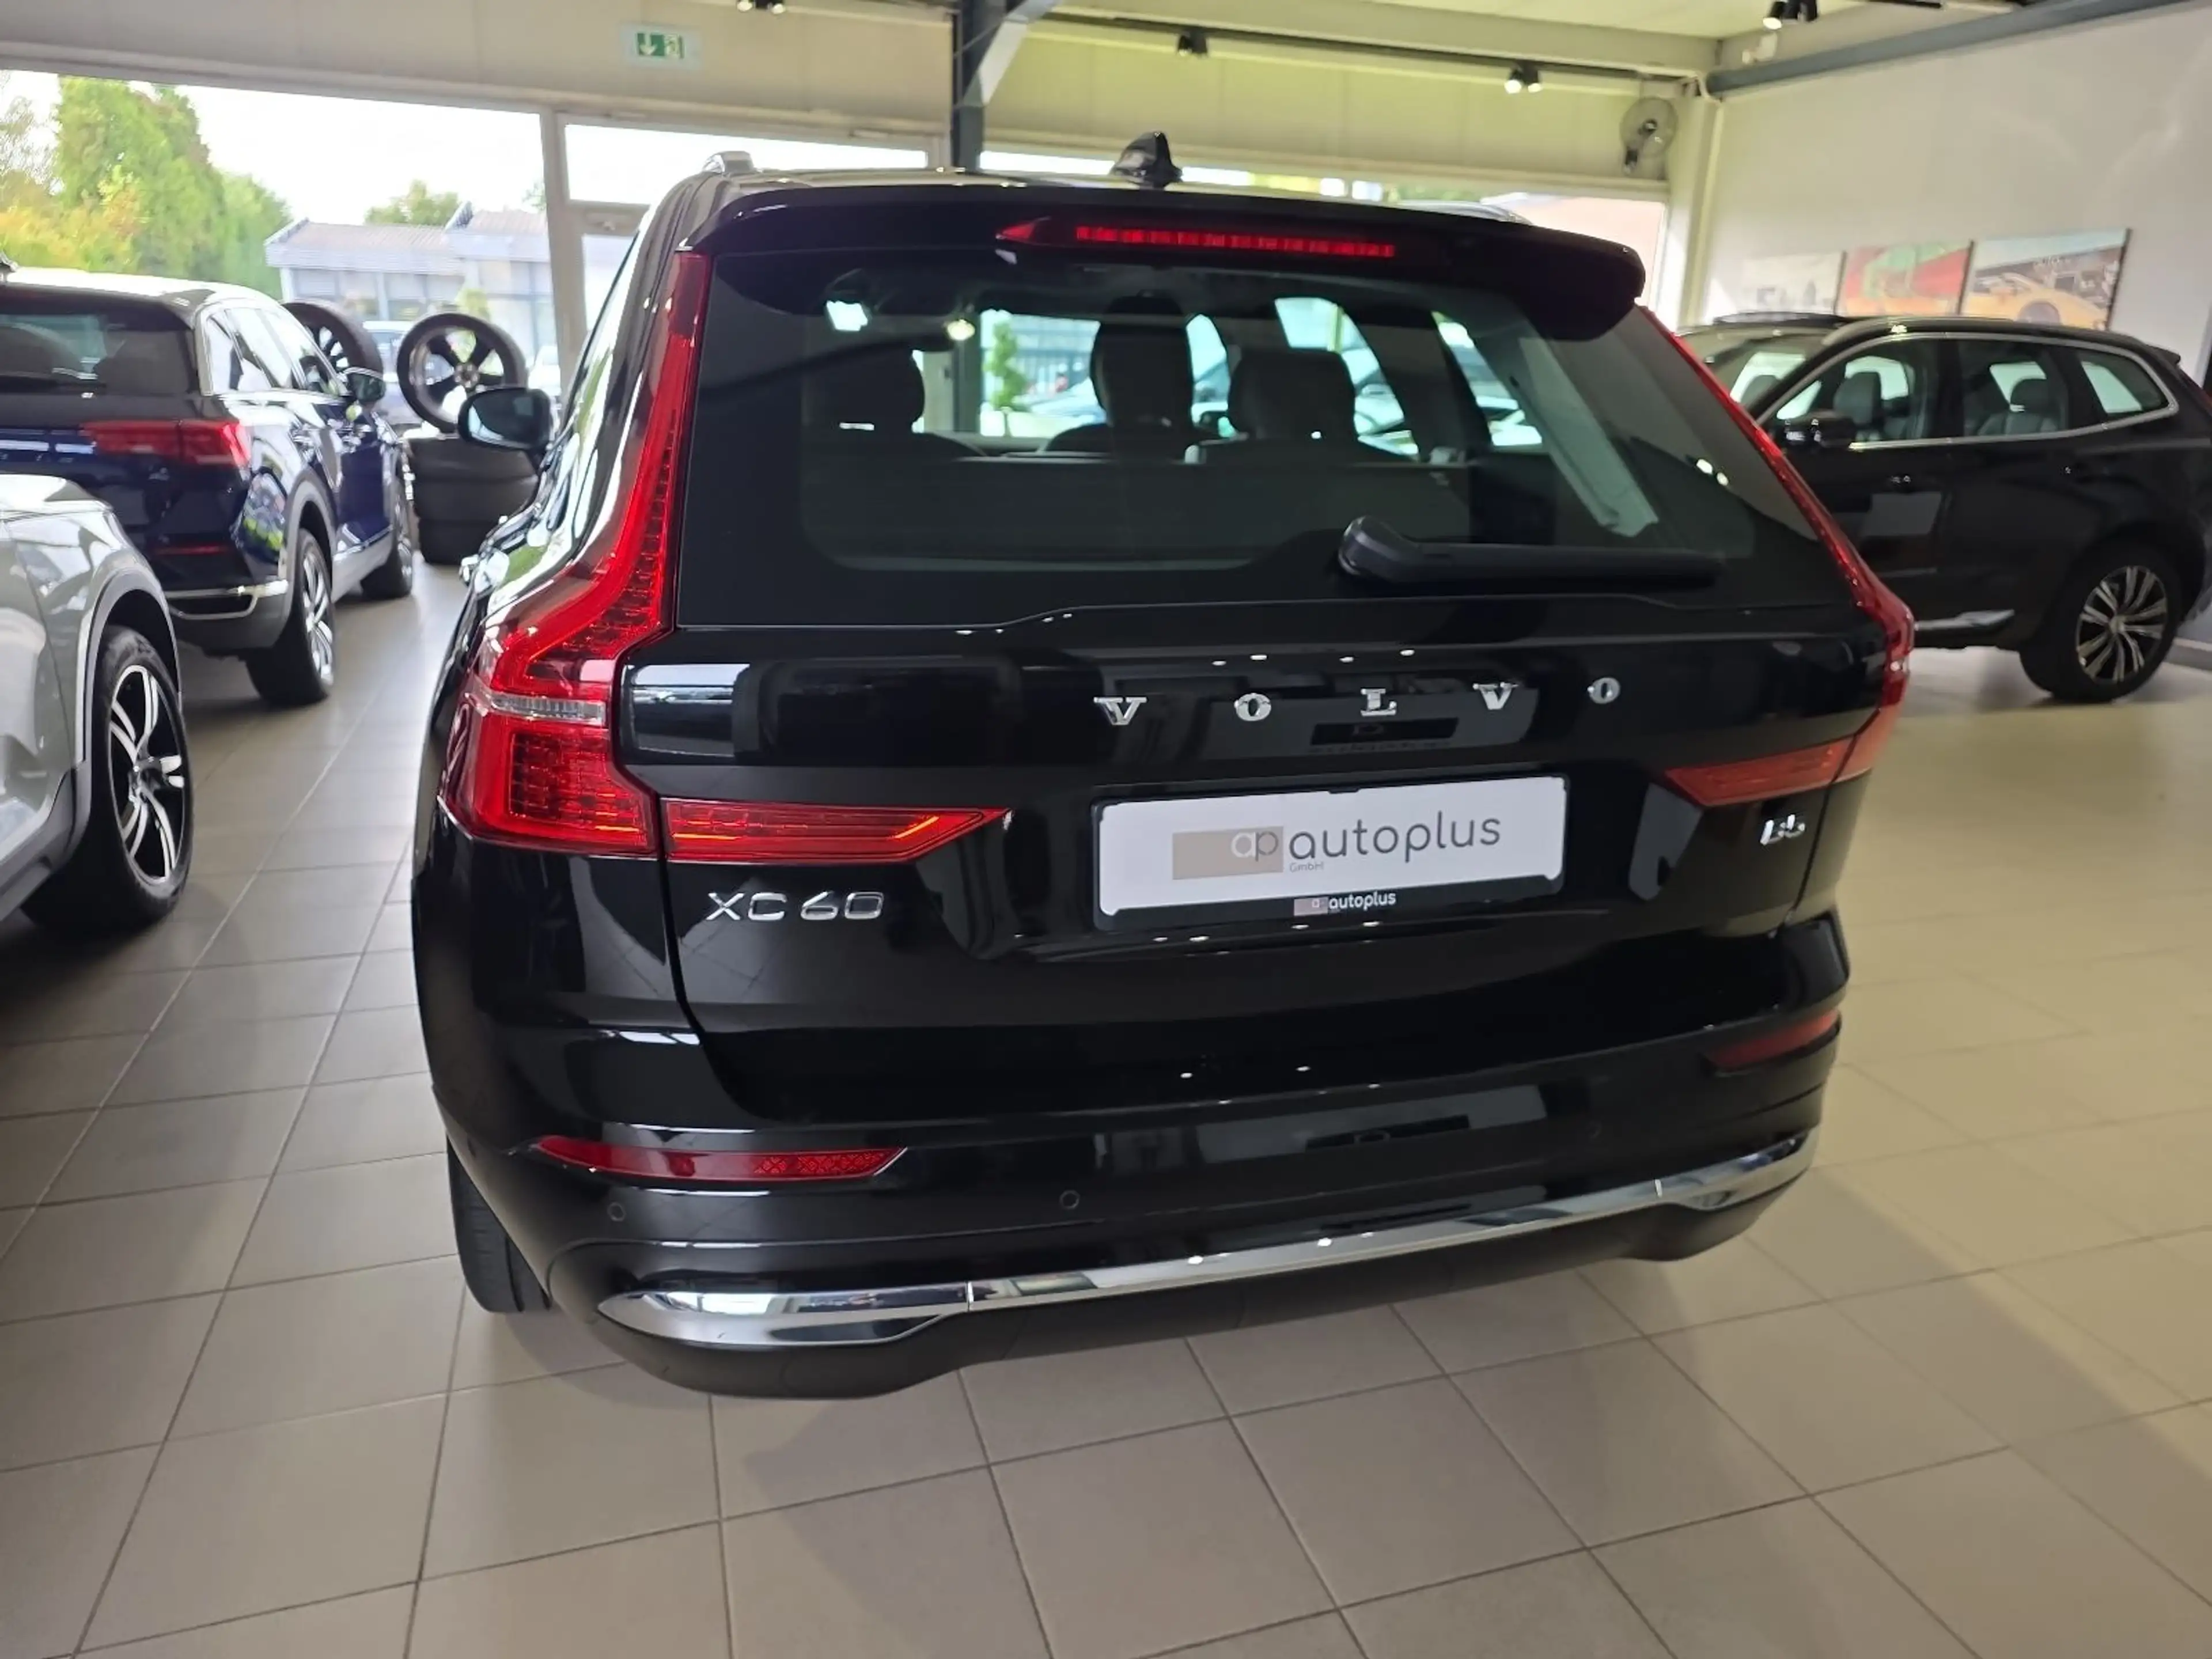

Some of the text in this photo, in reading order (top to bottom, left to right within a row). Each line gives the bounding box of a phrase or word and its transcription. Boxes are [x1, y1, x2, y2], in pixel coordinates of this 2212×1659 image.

[1093, 677, 1621, 726] VOLVO
[1288, 809, 1501, 863] autoplus
[1289, 861, 1324, 873] GmbH
[1328, 891, 1397, 911] autoplus
